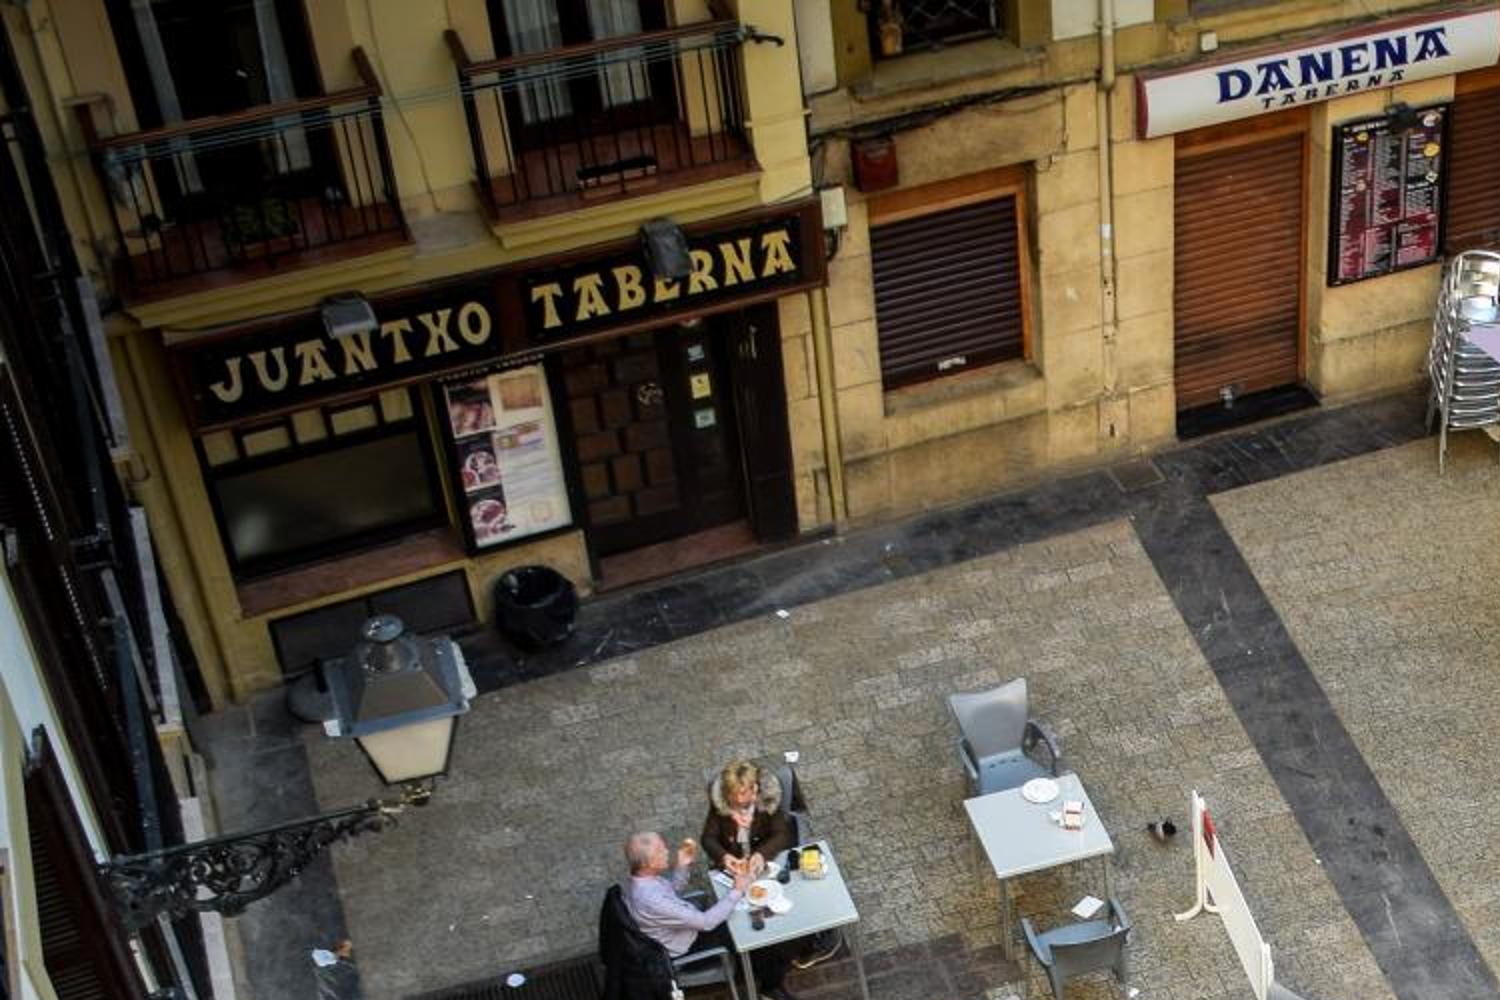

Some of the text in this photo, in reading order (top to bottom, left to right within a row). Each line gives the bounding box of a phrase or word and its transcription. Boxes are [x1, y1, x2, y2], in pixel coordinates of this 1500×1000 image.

[1215, 26, 1452, 104] DANENA
[1261, 69, 1406, 109] TABERNA
[209, 301, 492, 403] JUANTXO
